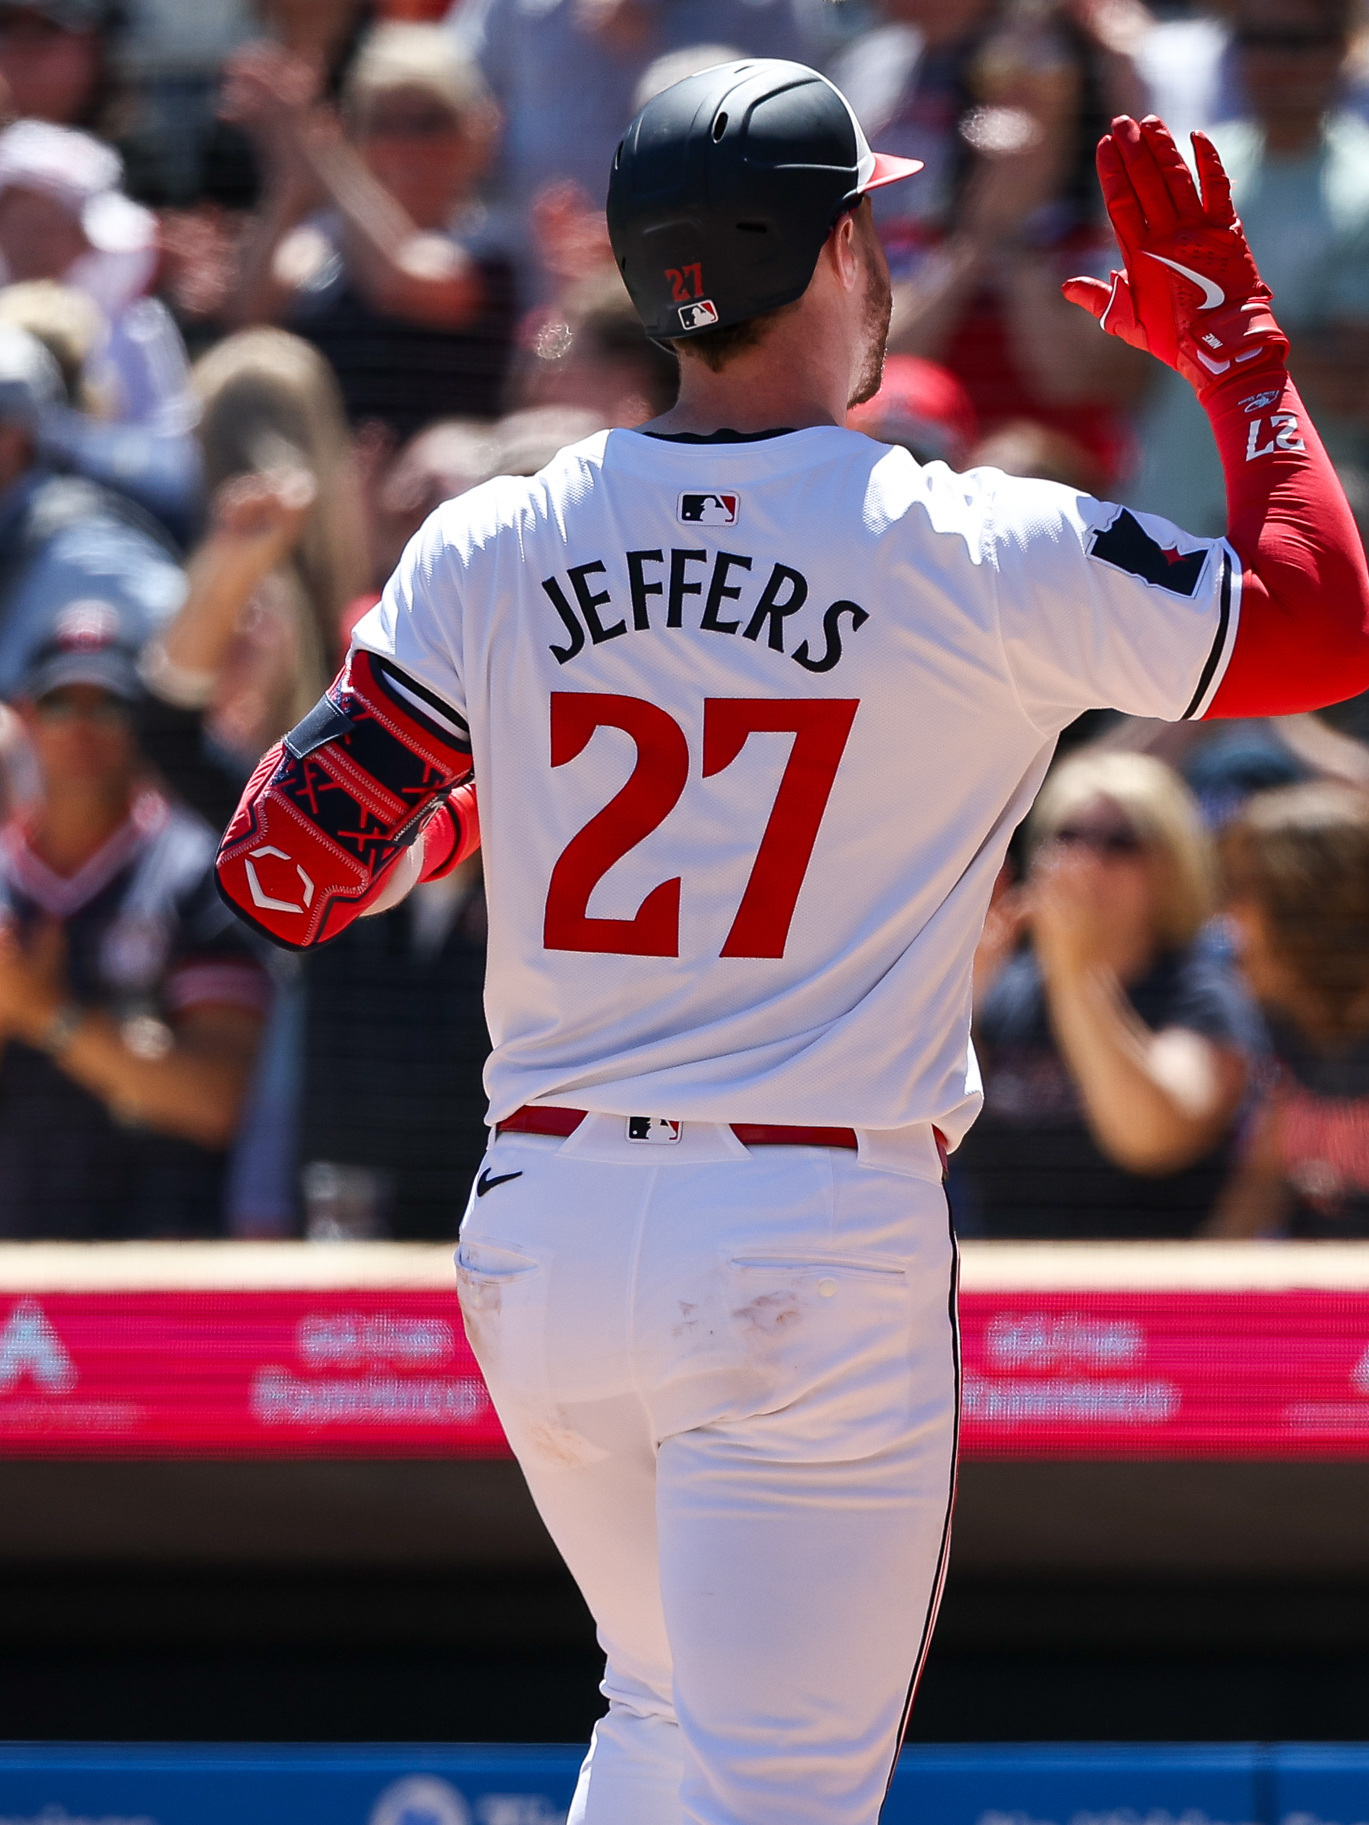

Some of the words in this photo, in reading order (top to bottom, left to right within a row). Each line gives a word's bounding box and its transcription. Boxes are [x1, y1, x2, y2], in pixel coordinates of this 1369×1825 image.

[664, 262, 704, 302] 27
[1202, 333, 1223, 349] NIKE
[1246, 415, 1306, 462] 27
[541, 548, 870, 673] JEFFERS
[543, 692, 861, 959] 27
